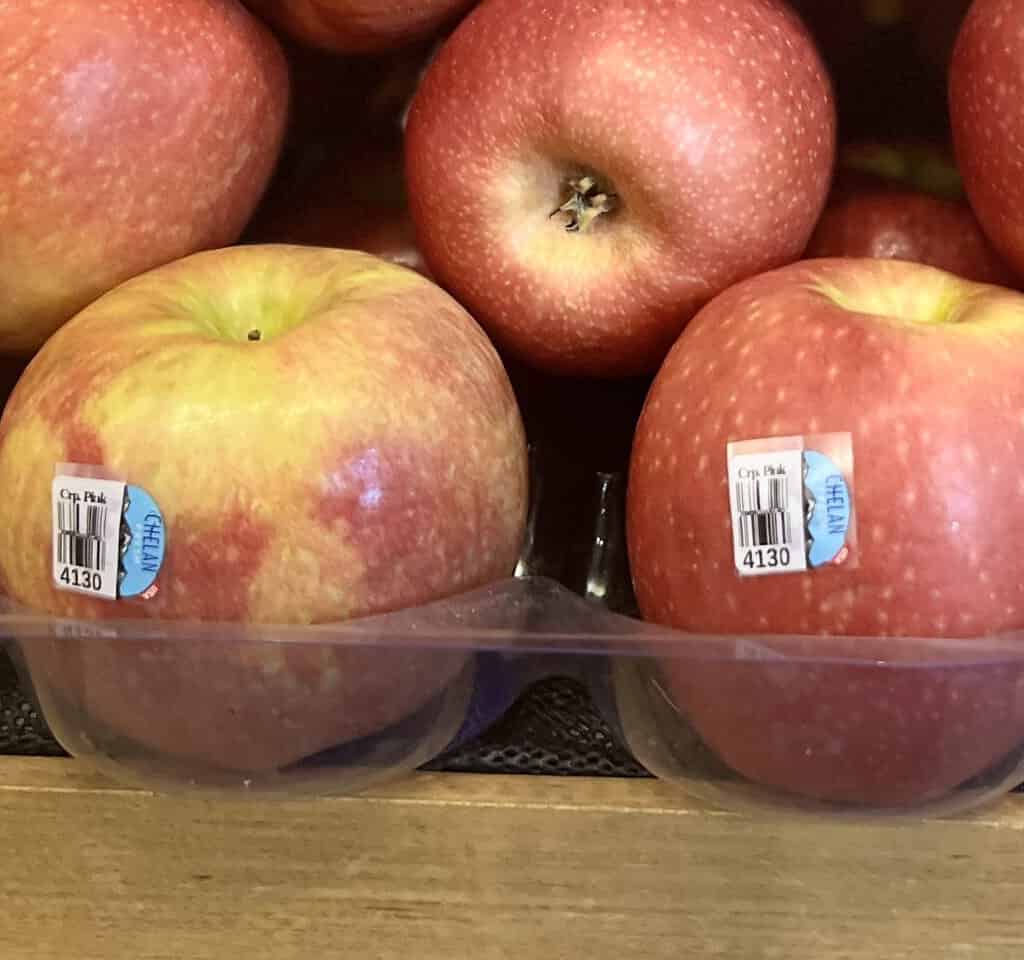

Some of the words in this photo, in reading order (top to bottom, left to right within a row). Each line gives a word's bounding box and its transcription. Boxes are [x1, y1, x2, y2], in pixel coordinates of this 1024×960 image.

[84, 491, 107, 504] Pink
[825, 474, 846, 536] CHELAN
[142, 513, 161, 573] CHELAN
[743, 547, 791, 569] 4130
[60, 566, 103, 591] 4130
